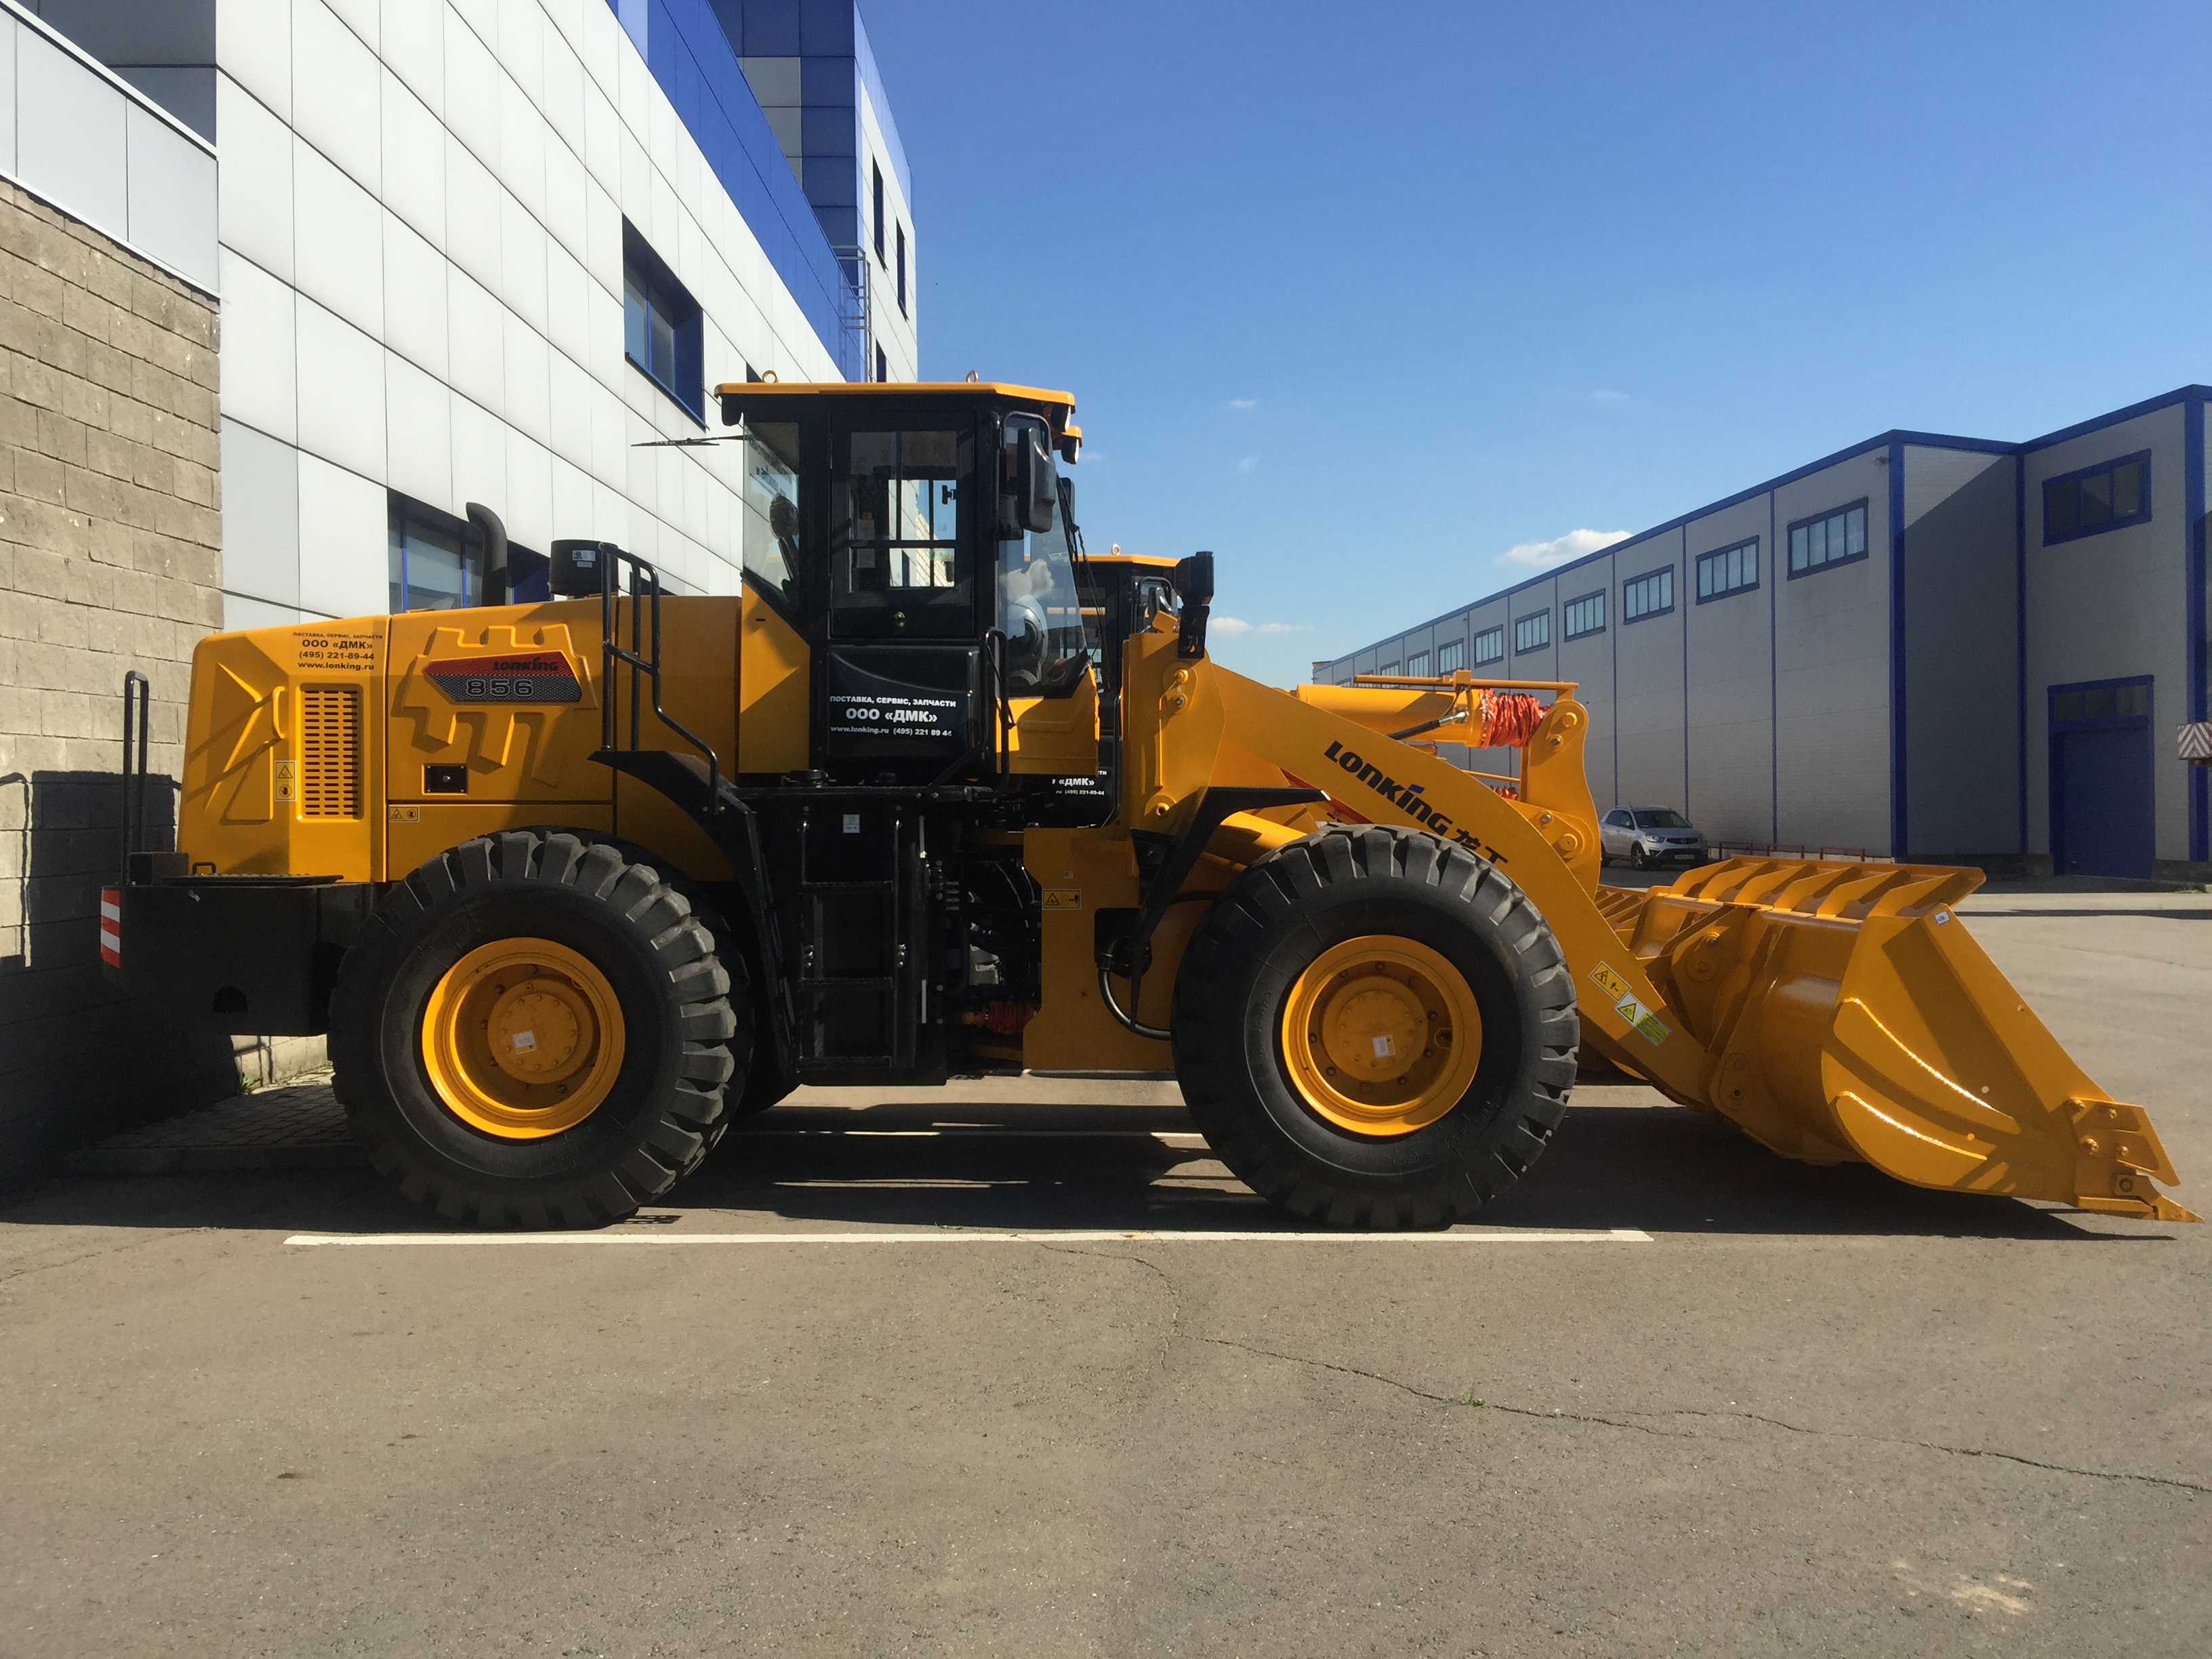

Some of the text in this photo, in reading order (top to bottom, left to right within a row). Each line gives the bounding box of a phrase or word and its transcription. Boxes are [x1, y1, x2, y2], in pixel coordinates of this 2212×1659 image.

[302, 639, 373, 650] ООО «ДМК»
[299, 651, 375, 660] (495) 221-89-44
[298, 662, 375, 671] www.lonking.ru
[466, 678, 534, 697] 856
[830, 695, 956, 708] ПОСТАВКА, СЕРВИС, ЗАПЧАСТИ
[846, 708, 938, 723] ООО «ДМК»
[830, 726, 889, 735] www.lonking.ru
[893, 727, 914, 736] (495)
[1059, 777, 1095, 787] «ДМК»
